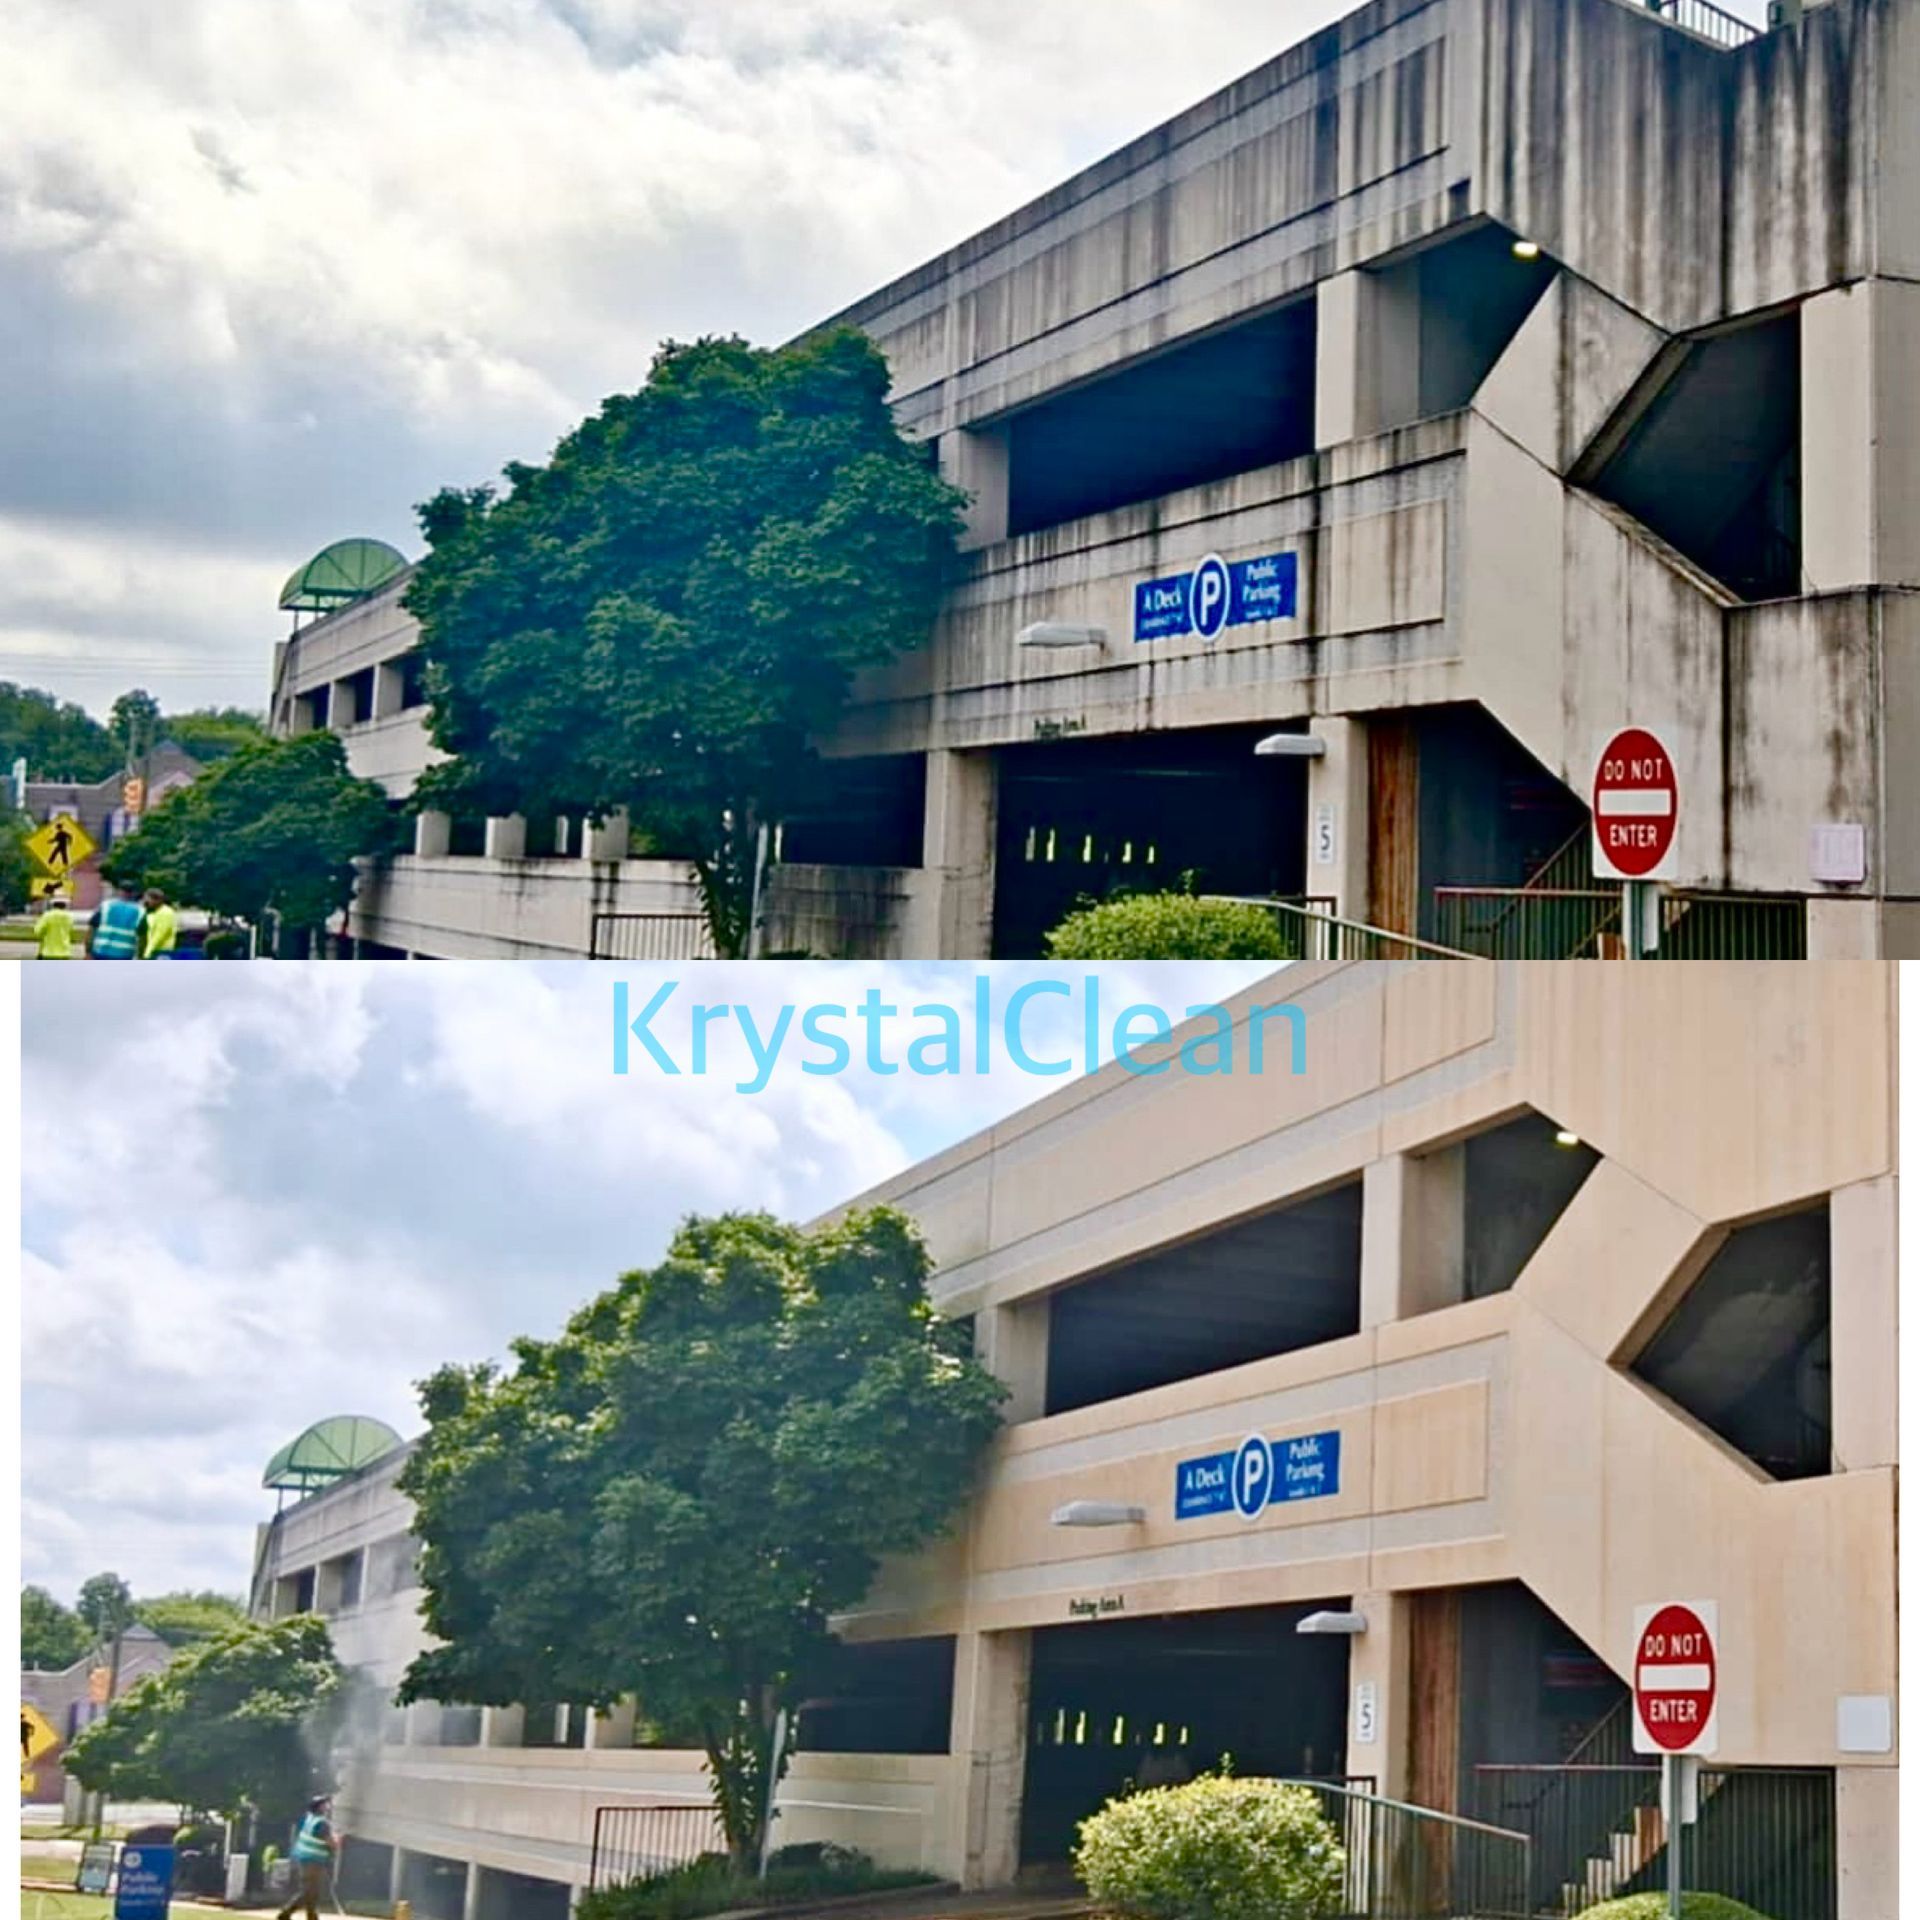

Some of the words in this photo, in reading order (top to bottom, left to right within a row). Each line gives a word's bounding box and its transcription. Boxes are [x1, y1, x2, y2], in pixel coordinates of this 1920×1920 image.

[1154, 586, 1182, 609] Deck
[1202, 571, 1221, 626] P
[1604, 759, 1625, 781] DO
[1630, 758, 1662, 780] NOT
[1320, 824, 1331, 851] 5
[1609, 824, 1657, 848] ENTER
[1289, 1437, 1320, 1459] Public
[1185, 1469, 1194, 1490] A
[1195, 1464, 1225, 1489] Deck
[1243, 1449, 1264, 1505] P
[1286, 1462, 1325, 1482] Parking
[1645, 1634, 1665, 1658] DO
[1671, 1633, 1703, 1656] NOT
[1361, 1703, 1372, 1729] 5
[1650, 1699, 1697, 1723] ENTER
